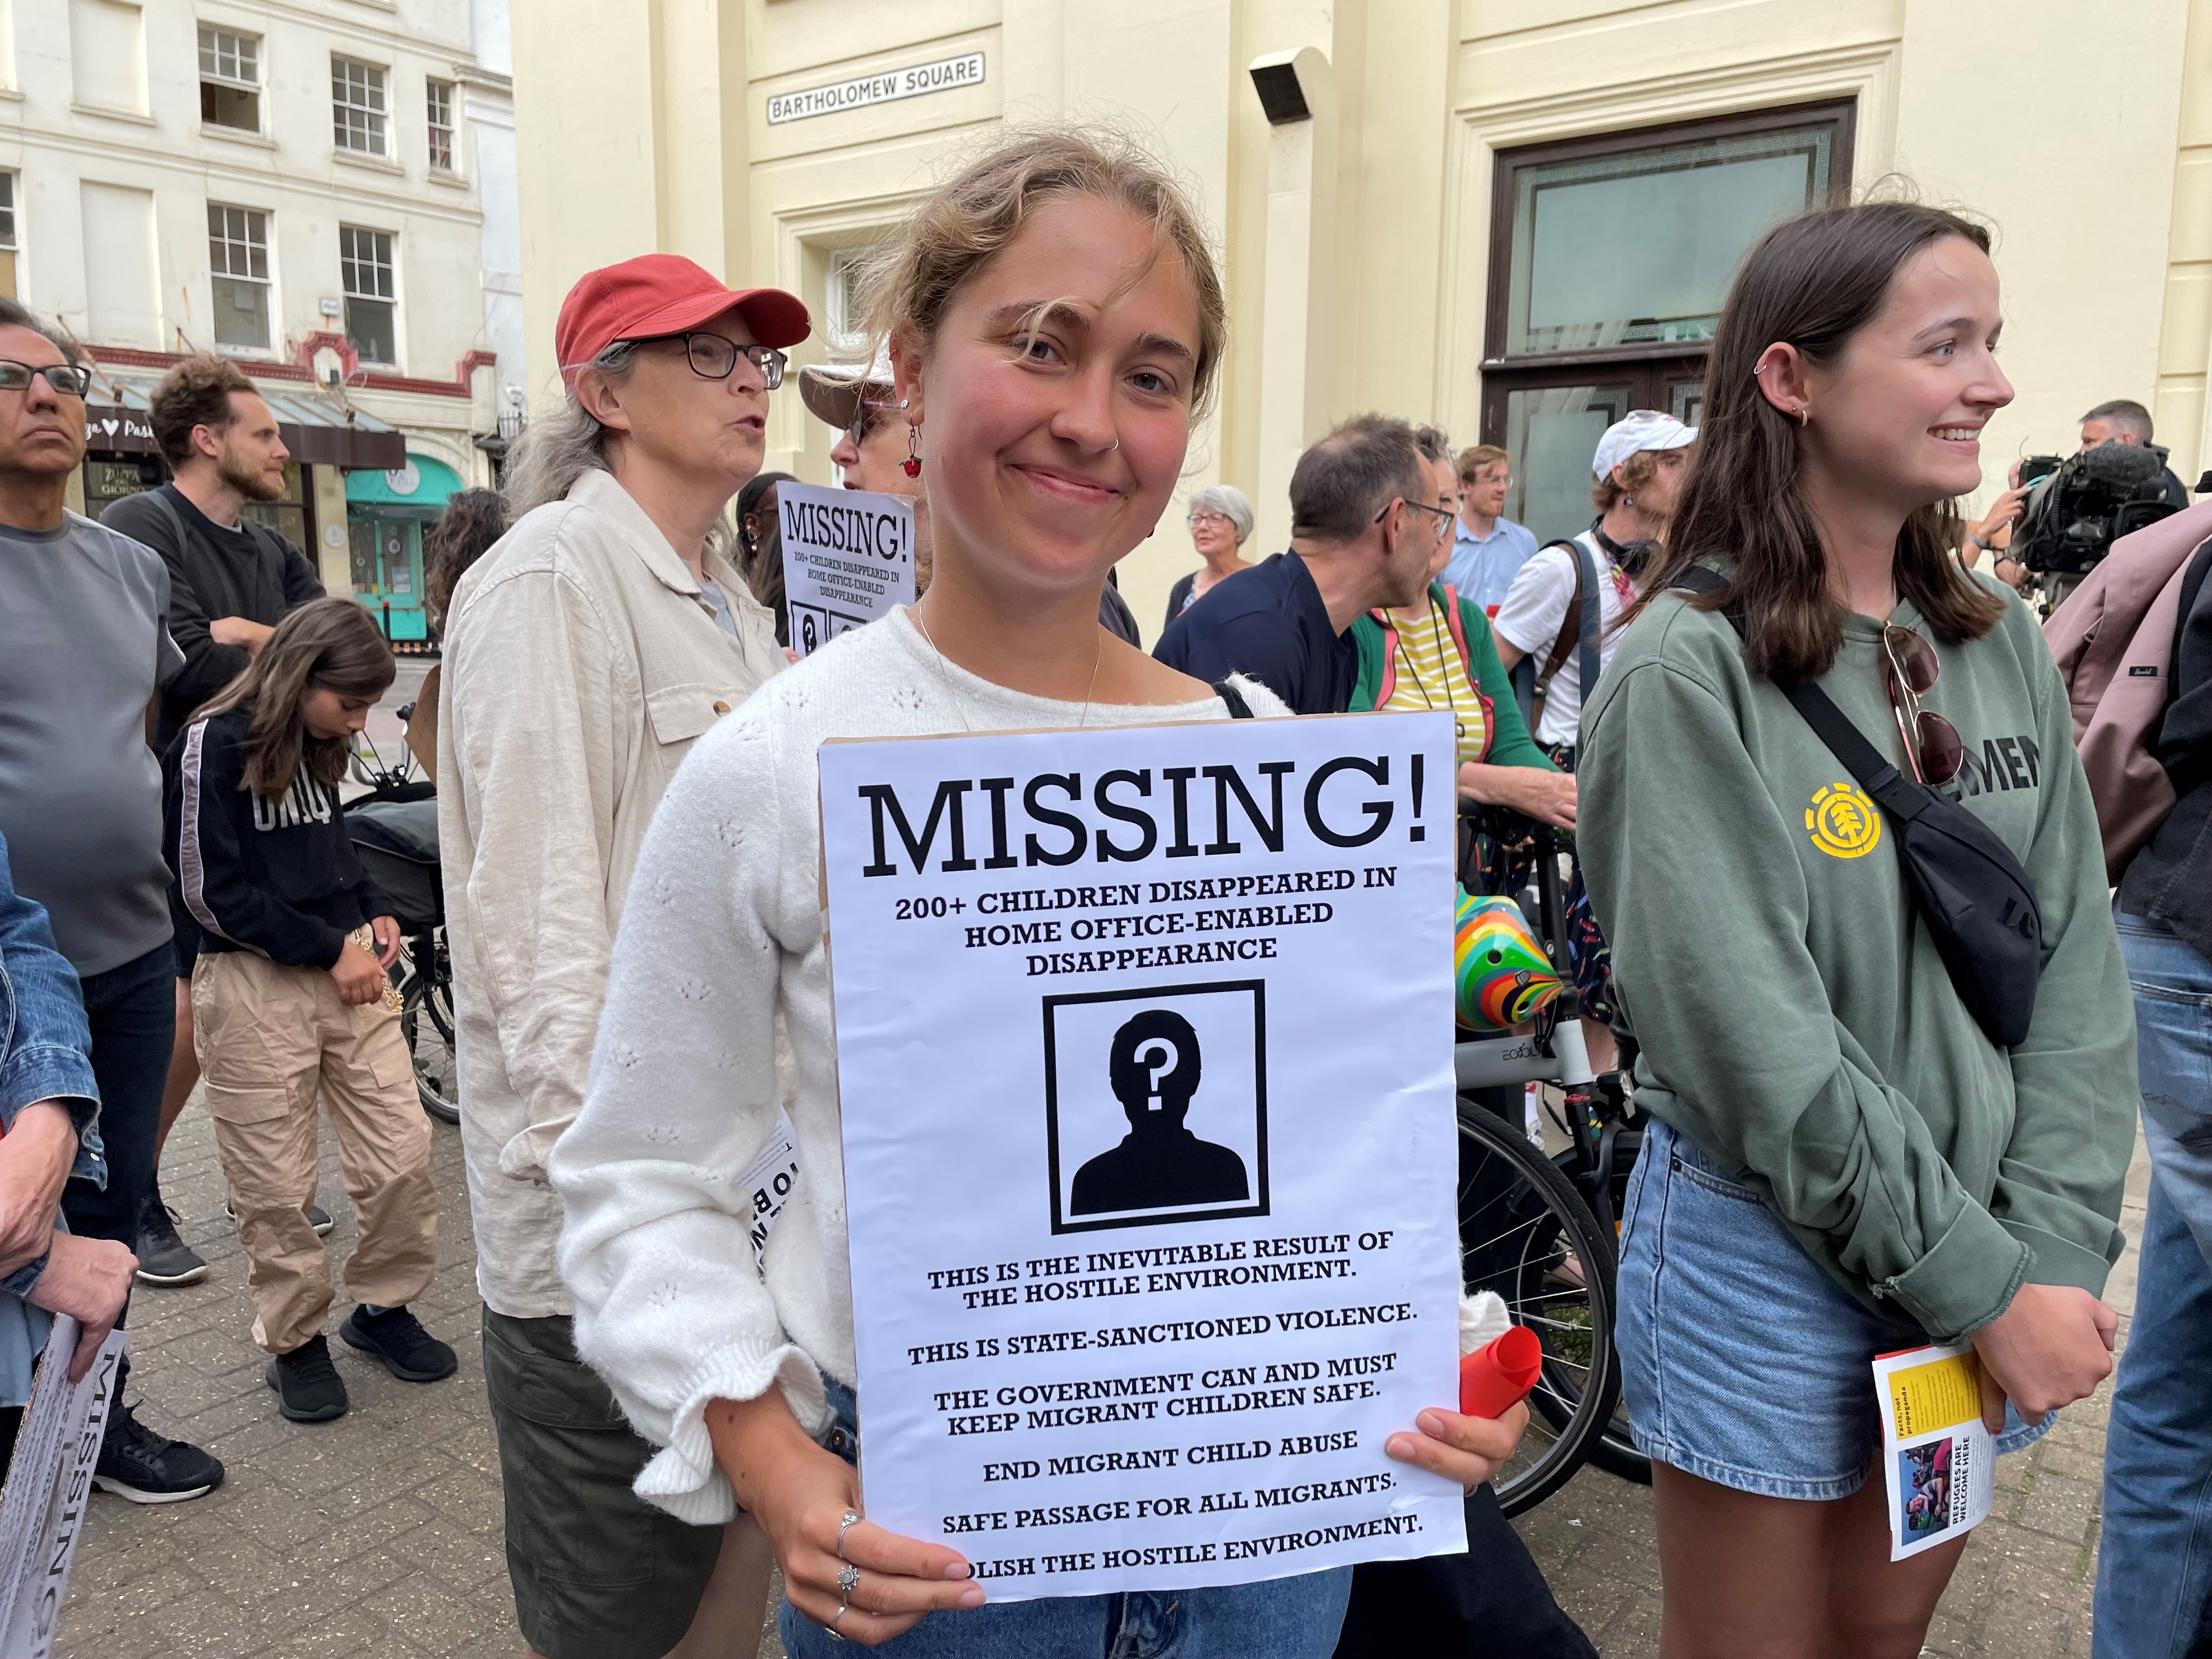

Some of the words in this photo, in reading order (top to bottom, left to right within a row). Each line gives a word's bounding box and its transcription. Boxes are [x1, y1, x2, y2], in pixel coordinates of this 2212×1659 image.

[772, 76, 897, 119] BARTHOLOMEW
[906, 59, 978, 91] SQUARE
[785, 500, 907, 563] MISSING!
[794, 551, 809, 562] 200+
[810, 554, 842, 571] CHILDREN
[843, 561, 889, 580] DISAPPEARED
[890, 571, 900, 583] IN
[808, 568, 827, 582] HOME
[827, 573, 885, 595] OFFICE-ENABLED
[820, 586, 873, 608] DISAPPEARANCE
[857, 753, 1426, 878] MISSING!
[895, 896, 966, 920] 200+
[977, 883, 1141, 914] CHILDREN
[1148, 870, 1355, 904] DISAPPEARED
[1363, 866, 1397, 888] IN
[964, 921, 1062, 948] HOME
[1070, 902, 1333, 940] OFFICE-ENABLED
[1026, 938, 1277, 976] DISAPPEARANCE
[927, 1266, 989, 1290] THIS
[996, 1262, 1019, 1282] IS
[1026, 1256, 1080, 1278] THE
[1086, 1241, 1246, 1272] INEVITABLE
[1252, 1234, 1350, 1258] RESULT
[1358, 1231, 1393, 1250] OF
[963, 1286, 1017, 1310] THE
[1024, 1276, 1140, 1303] HOSTILE
[1147, 1259, 1356, 1293] ENVIRONMENT.
[907, 1341, 969, 1365] THIS
[975, 1339, 1000, 1357] IS
[1007, 1316, 1271, 1355] STATE-SANCTIONED
[1275, 1302, 1418, 1331] VIOLENCE.
[934, 1389, 989, 1411] THE
[996, 1373, 1194, 1406] GOVERNMENT
[1201, 1367, 1257, 1389] CAN
[1263, 1362, 1319, 1384] AND
[1327, 1352, 1397, 1378] MUST
[947, 1413, 1020, 1436] KEEP
[1026, 1401, 1159, 1429] MIGRANT
[1166, 1387, 1306, 1417] CHILDREN
[1313, 1380, 1380, 1404] SAFE.
[1901, 1386, 1913, 1434] propaganda
[983, 1460, 1040, 1482] END
[1047, 1448, 1179, 1476] MIGRANT
[1187, 1441, 1271, 1464] CHILD
[1278, 1430, 1358, 1456] ABUSE
[943, 1511, 1008, 1533] SAFE
[1014, 1502, 1130, 1528] PASSAGE
[1136, 1497, 1193, 1518] FOR
[1198, 1491, 1249, 1514] ALL
[1254, 1472, 1397, 1508] MIGRANTS.
[1953, 1468, 1961, 1525] REFUGEES
[1960, 1467, 1968, 1523] WELCOME
[1041, 1553, 1095, 1573] THE
[1102, 1543, 1216, 1568] HOSTILE
[1223, 1514, 1423, 1560] ENVIRONMENT.
